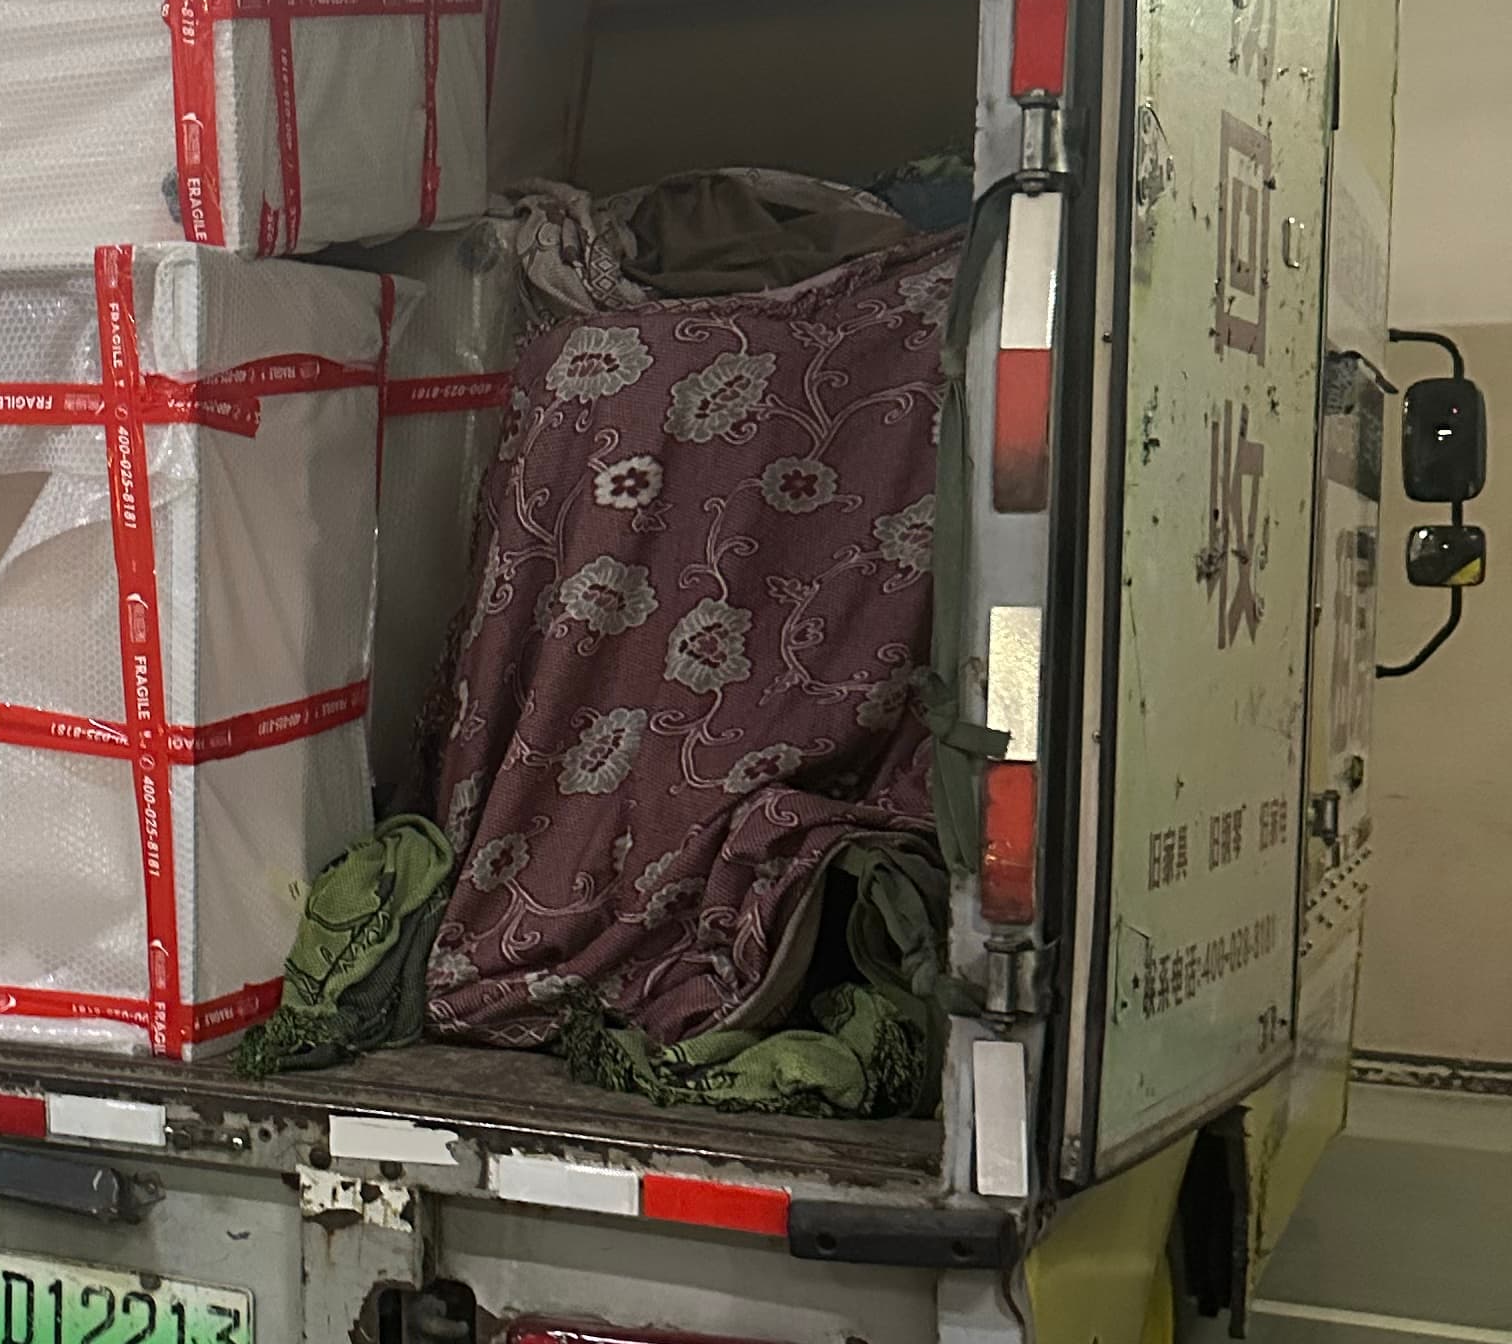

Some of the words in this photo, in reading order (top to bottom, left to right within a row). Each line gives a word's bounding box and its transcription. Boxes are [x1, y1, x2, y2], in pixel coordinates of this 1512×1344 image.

[117, 426, 136, 529] 400-025-8181
[134, 655, 150, 720] FRAGILE
[143, 776, 159, 876] 400-025-8181
